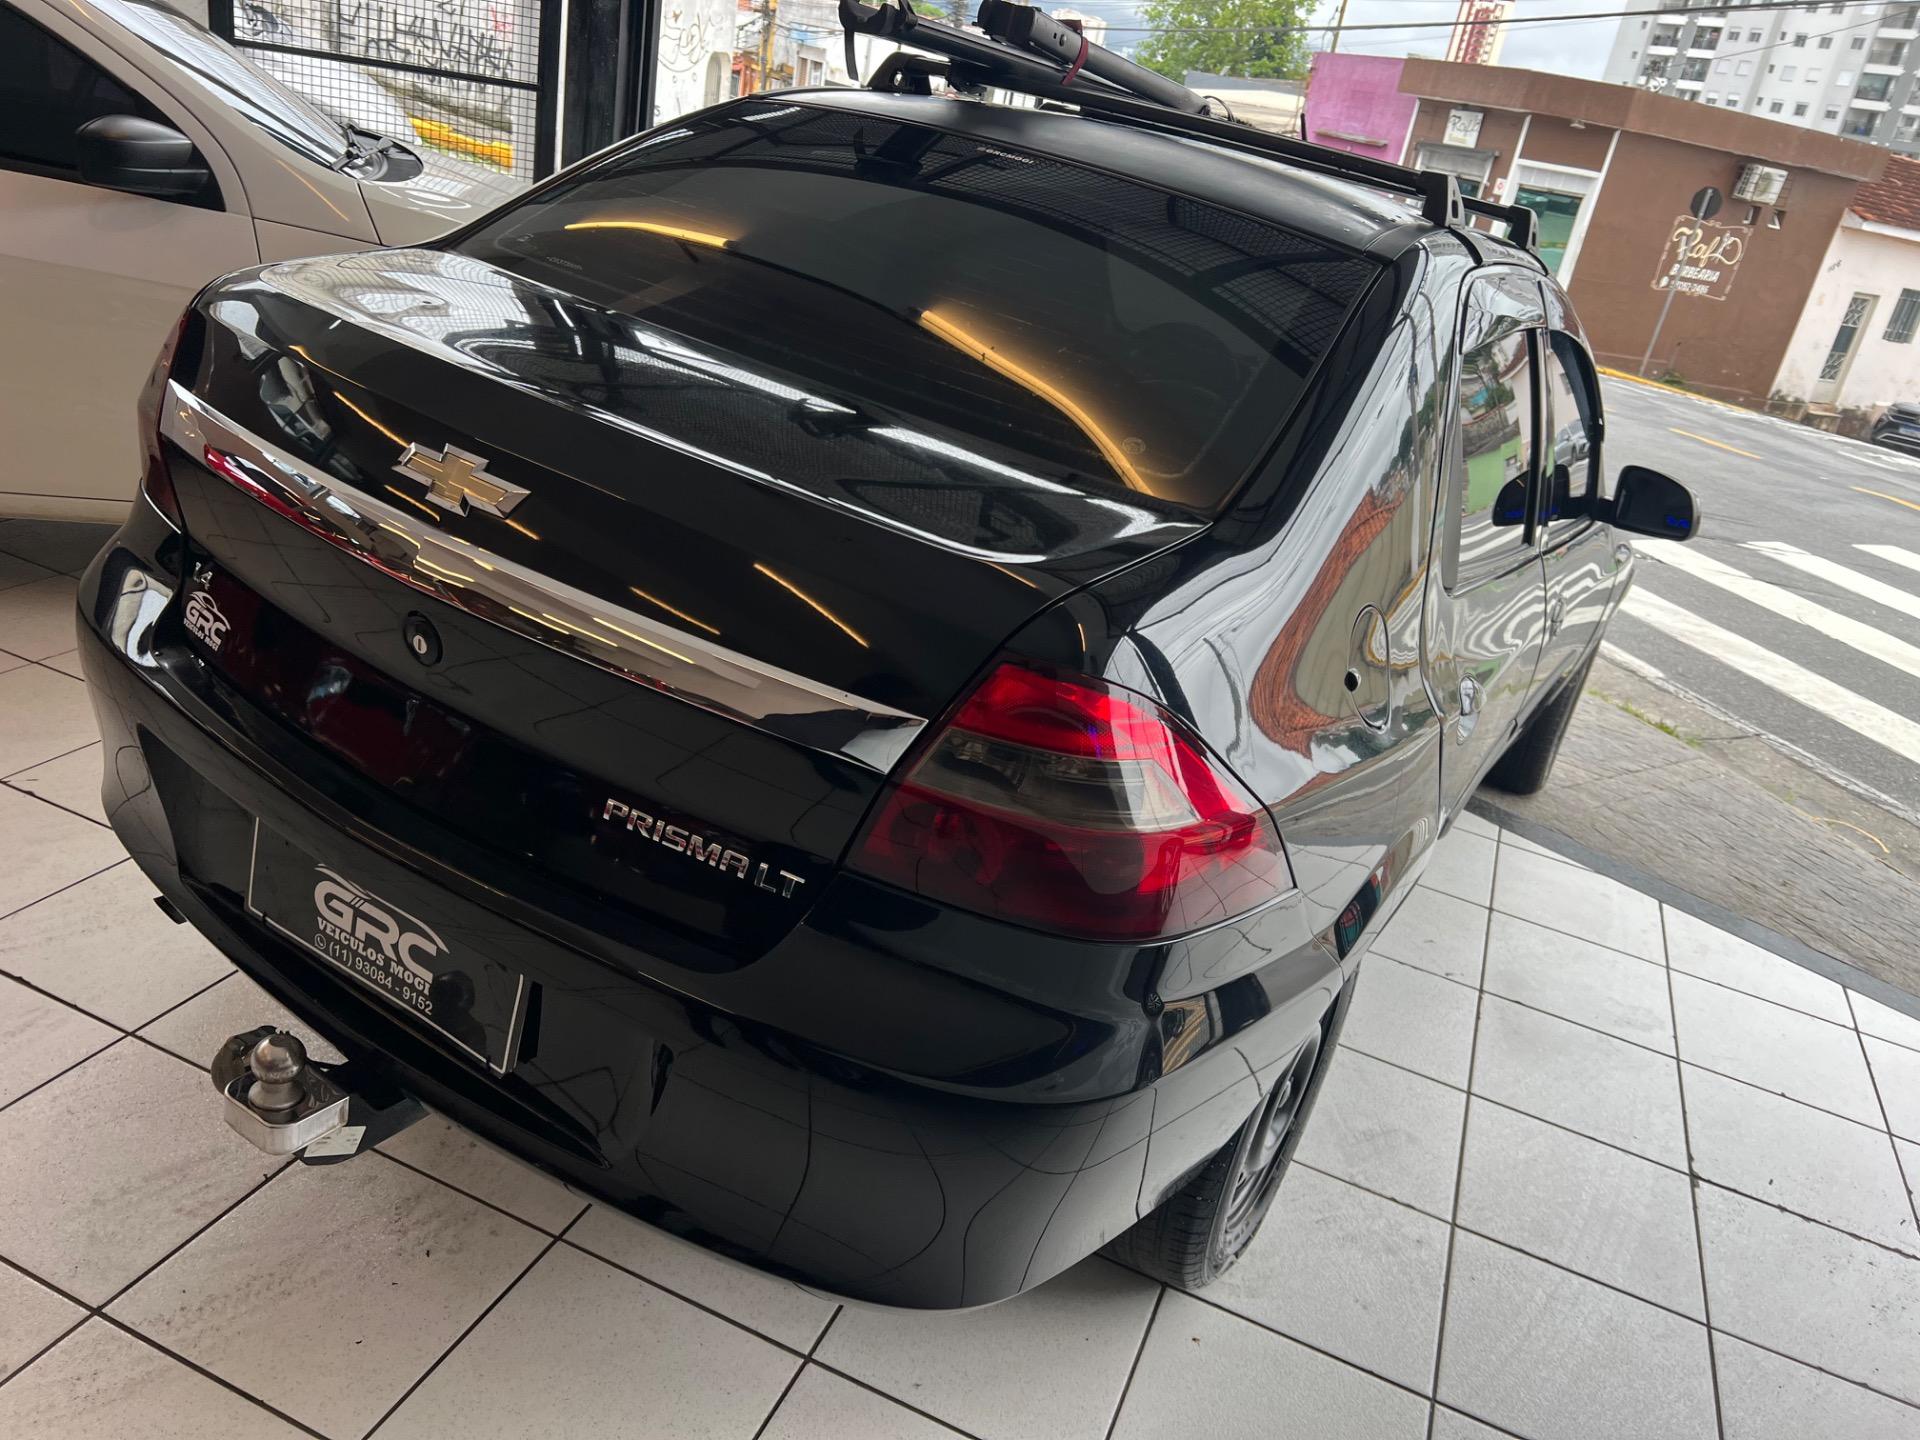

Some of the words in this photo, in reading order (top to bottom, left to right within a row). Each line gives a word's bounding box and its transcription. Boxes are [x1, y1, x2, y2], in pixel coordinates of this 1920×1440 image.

[1669, 263, 1720, 283] BRBEARIA
[186, 600, 226, 646] GRC
[603, 798, 750, 880] PRISMA
[754, 862, 806, 899] LT
[314, 880, 437, 985] GRC
[317, 917, 384, 966] VEICULOS
[390, 960, 432, 996] MOGI
[328, 942, 353, 967] (11)
[355, 957, 393, 989] 93084
[402, 986, 434, 1016] 9152
